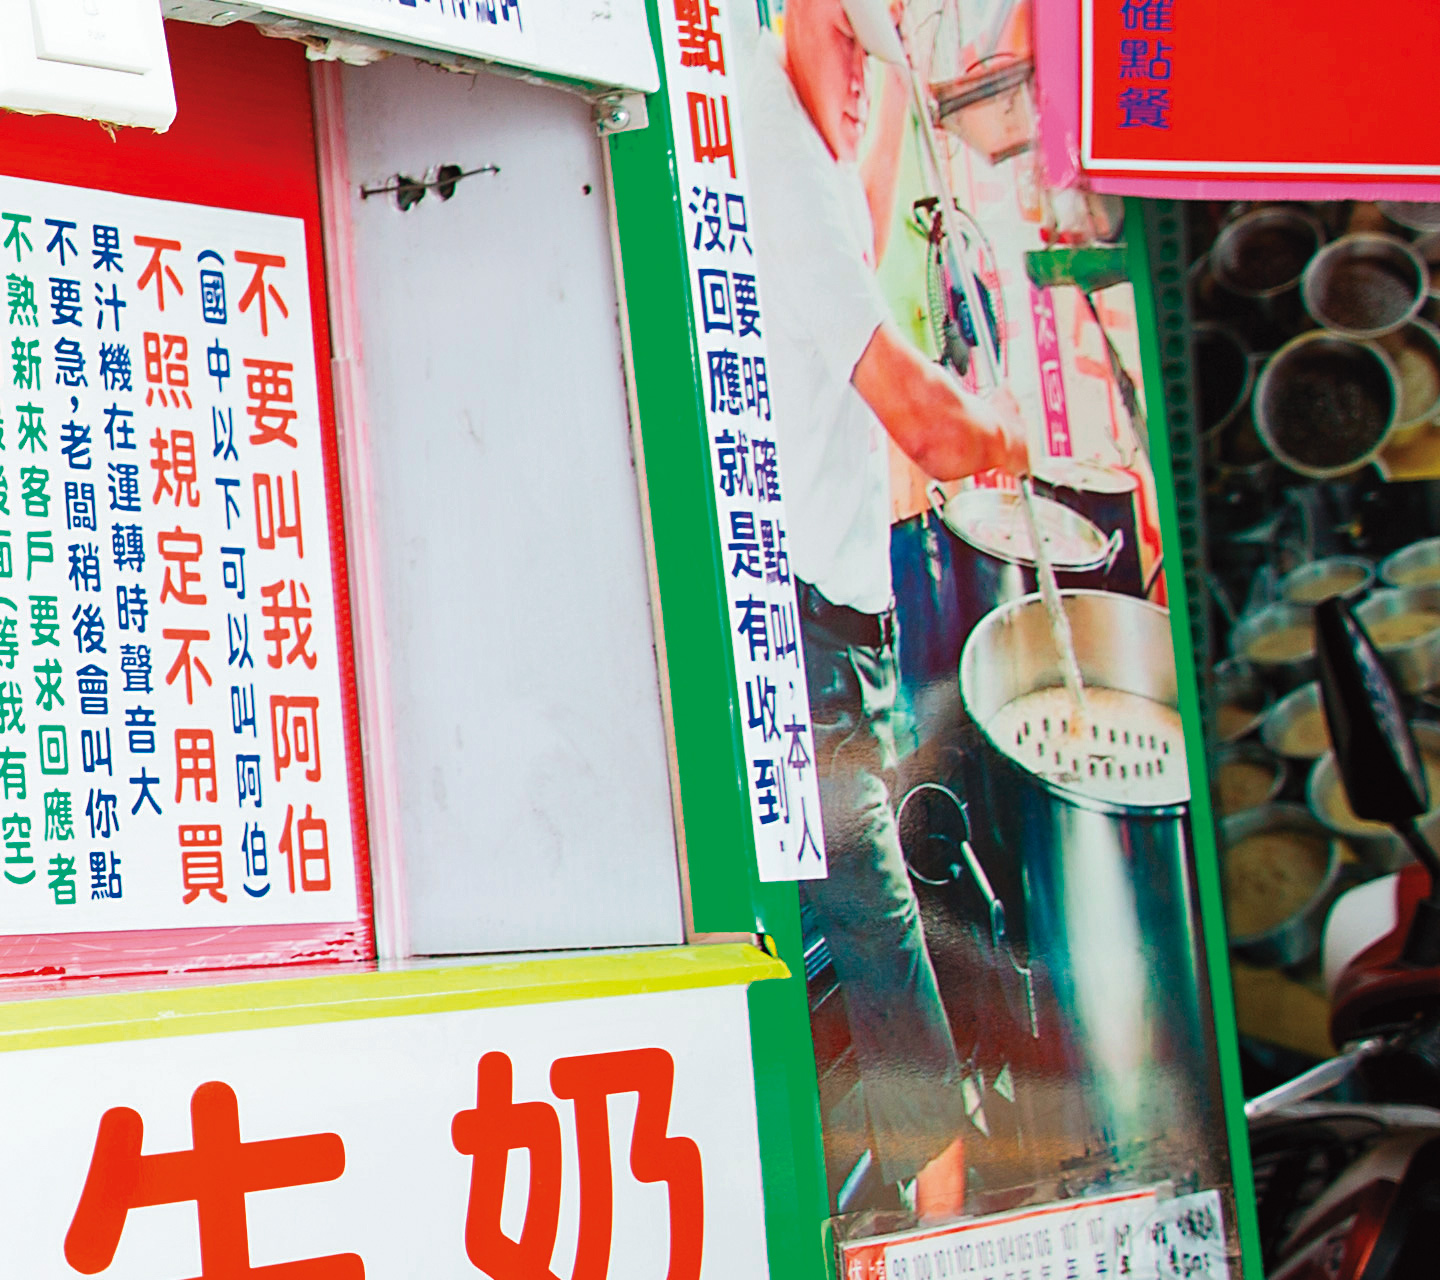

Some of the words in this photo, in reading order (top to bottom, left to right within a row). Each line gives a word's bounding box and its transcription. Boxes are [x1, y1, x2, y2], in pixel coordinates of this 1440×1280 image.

[1, 211, 78, 907] 不熟新來客戶要求回應者
[91, 224, 163, 817] 果汁機在運轉時聲音大
[133, 234, 229, 906] 不照規定不用買
[196, 249, 271, 899] (國中以下可以叫阿伯)
[234, 249, 332, 895] 不要叫我阿伯
